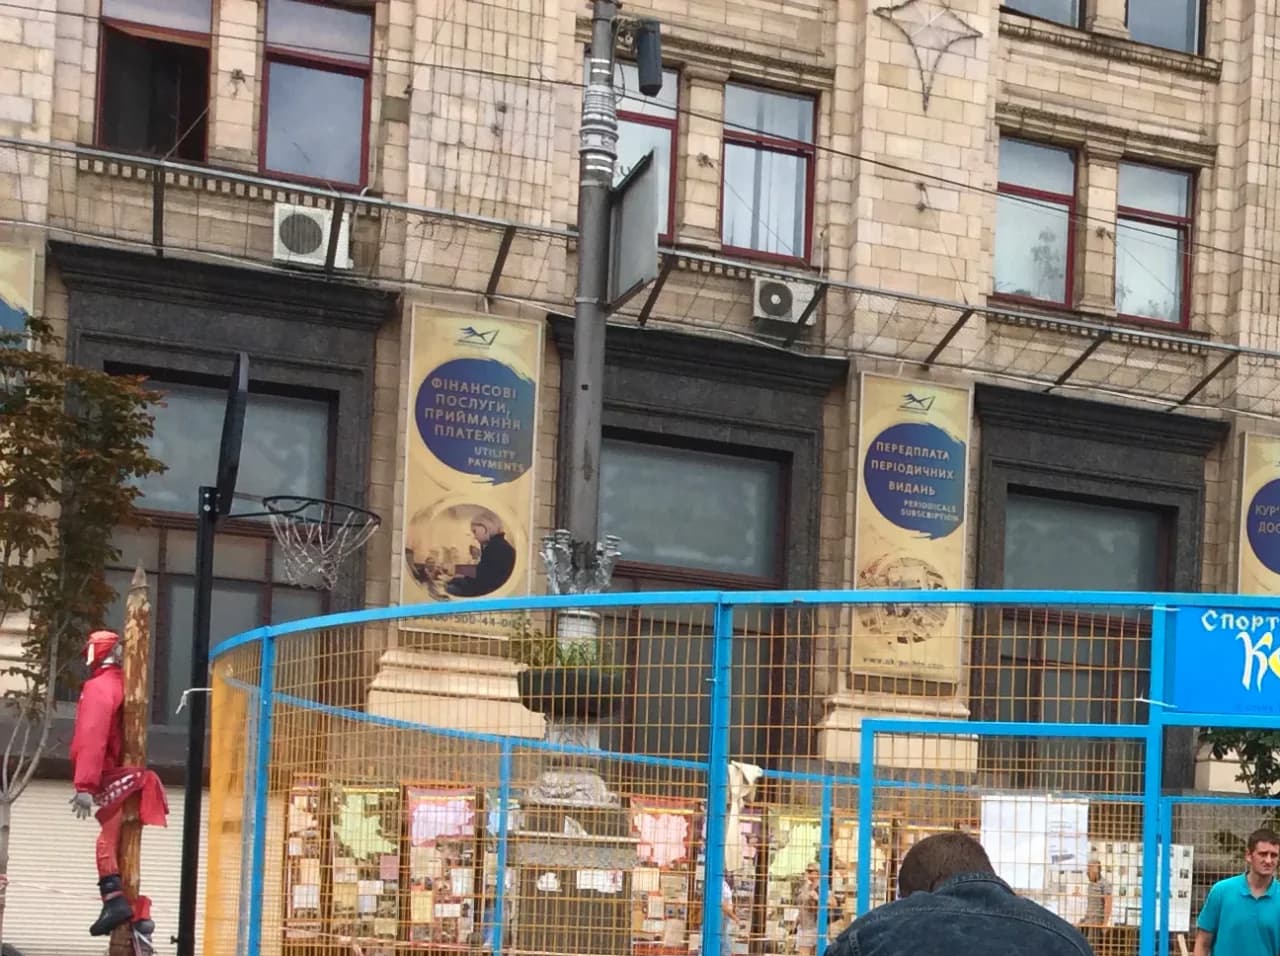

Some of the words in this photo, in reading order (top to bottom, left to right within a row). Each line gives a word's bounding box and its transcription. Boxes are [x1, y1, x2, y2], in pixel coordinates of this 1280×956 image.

[431, 377, 517, 398] ФІНАНСОВІ
[435, 393, 511, 418] ПОСЛУГИ,
[425, 407, 521, 431] ПРИЙМАННЯ
[434, 424, 511, 445] ПЛАТЕЖІВ
[474, 446, 516, 459] UTILITY
[876, 441, 950, 460] ПЕРЕДПЛАТА
[468, 458, 525, 473] PAYMENTS
[871, 459, 954, 479] ПЕРІОДИЧНИХ
[888, 481, 936, 496] ВИДАНЬ
